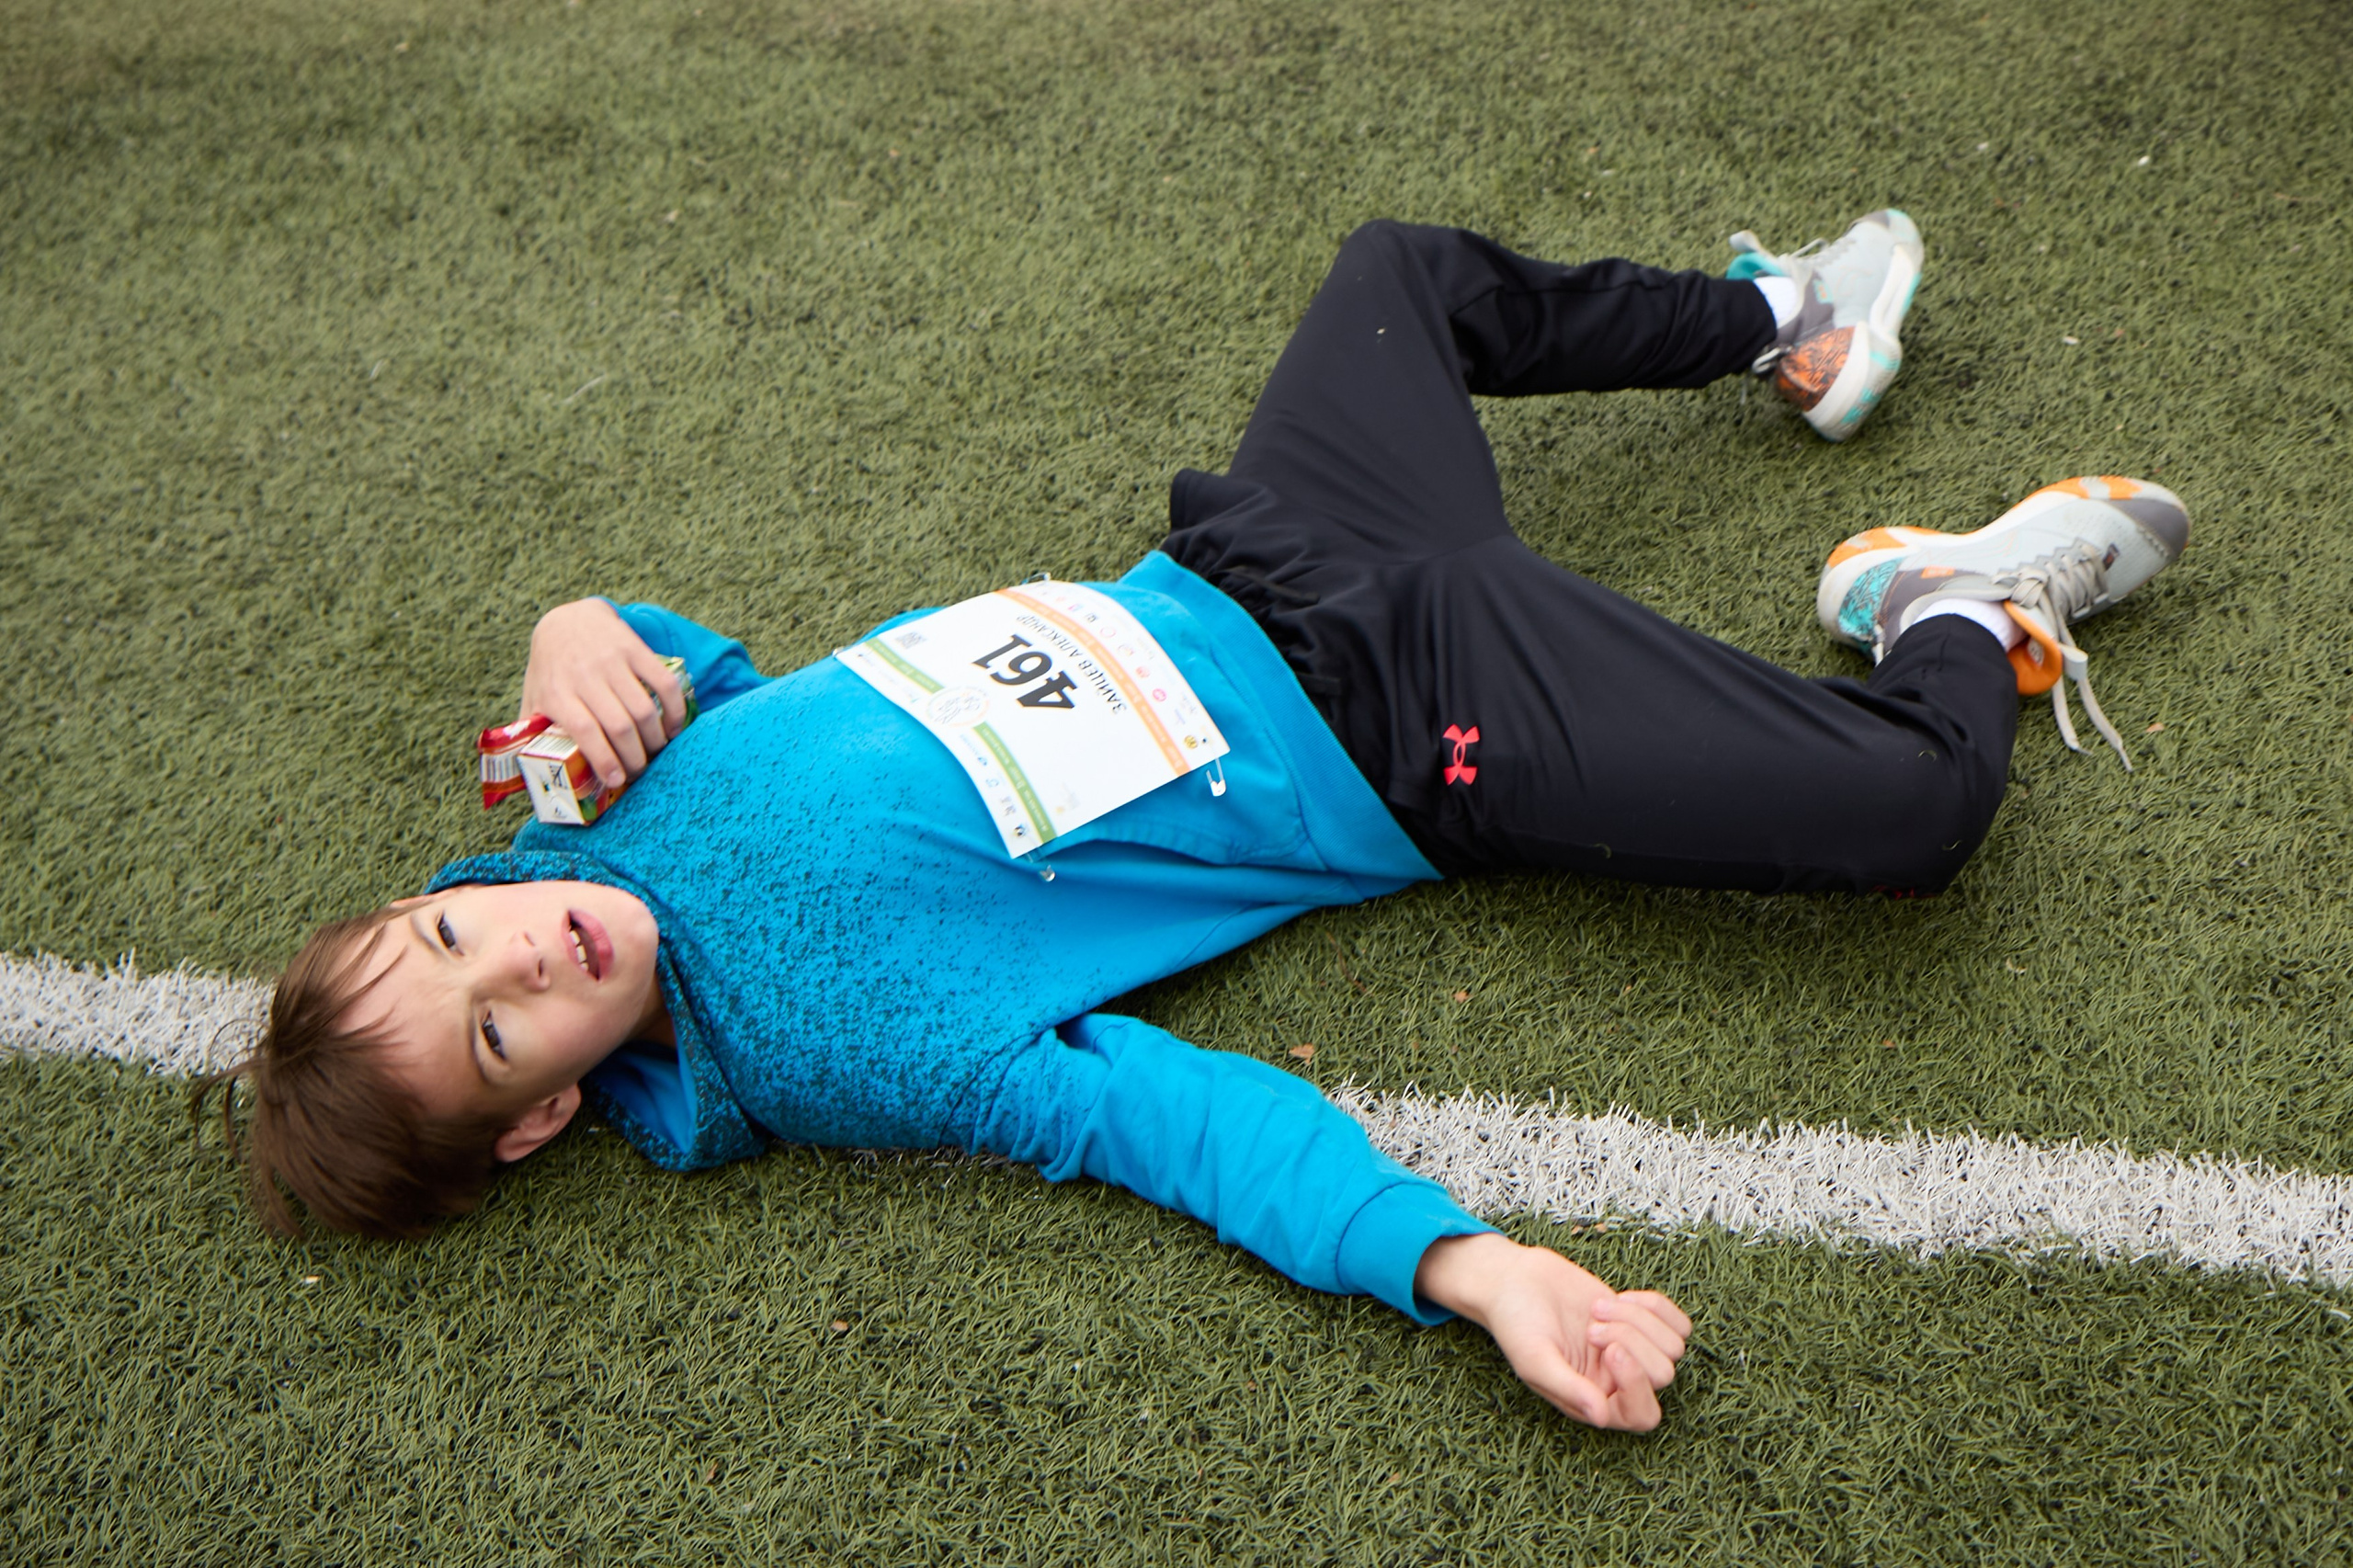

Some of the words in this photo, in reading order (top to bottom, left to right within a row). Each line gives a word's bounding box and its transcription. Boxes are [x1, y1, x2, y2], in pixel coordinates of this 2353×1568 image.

[1016, 614, 1083, 658] АЛЕКСАНДР
[972, 633, 1078, 709] 461
[1078, 660, 1127, 714] ЗАЙЦЕВ
